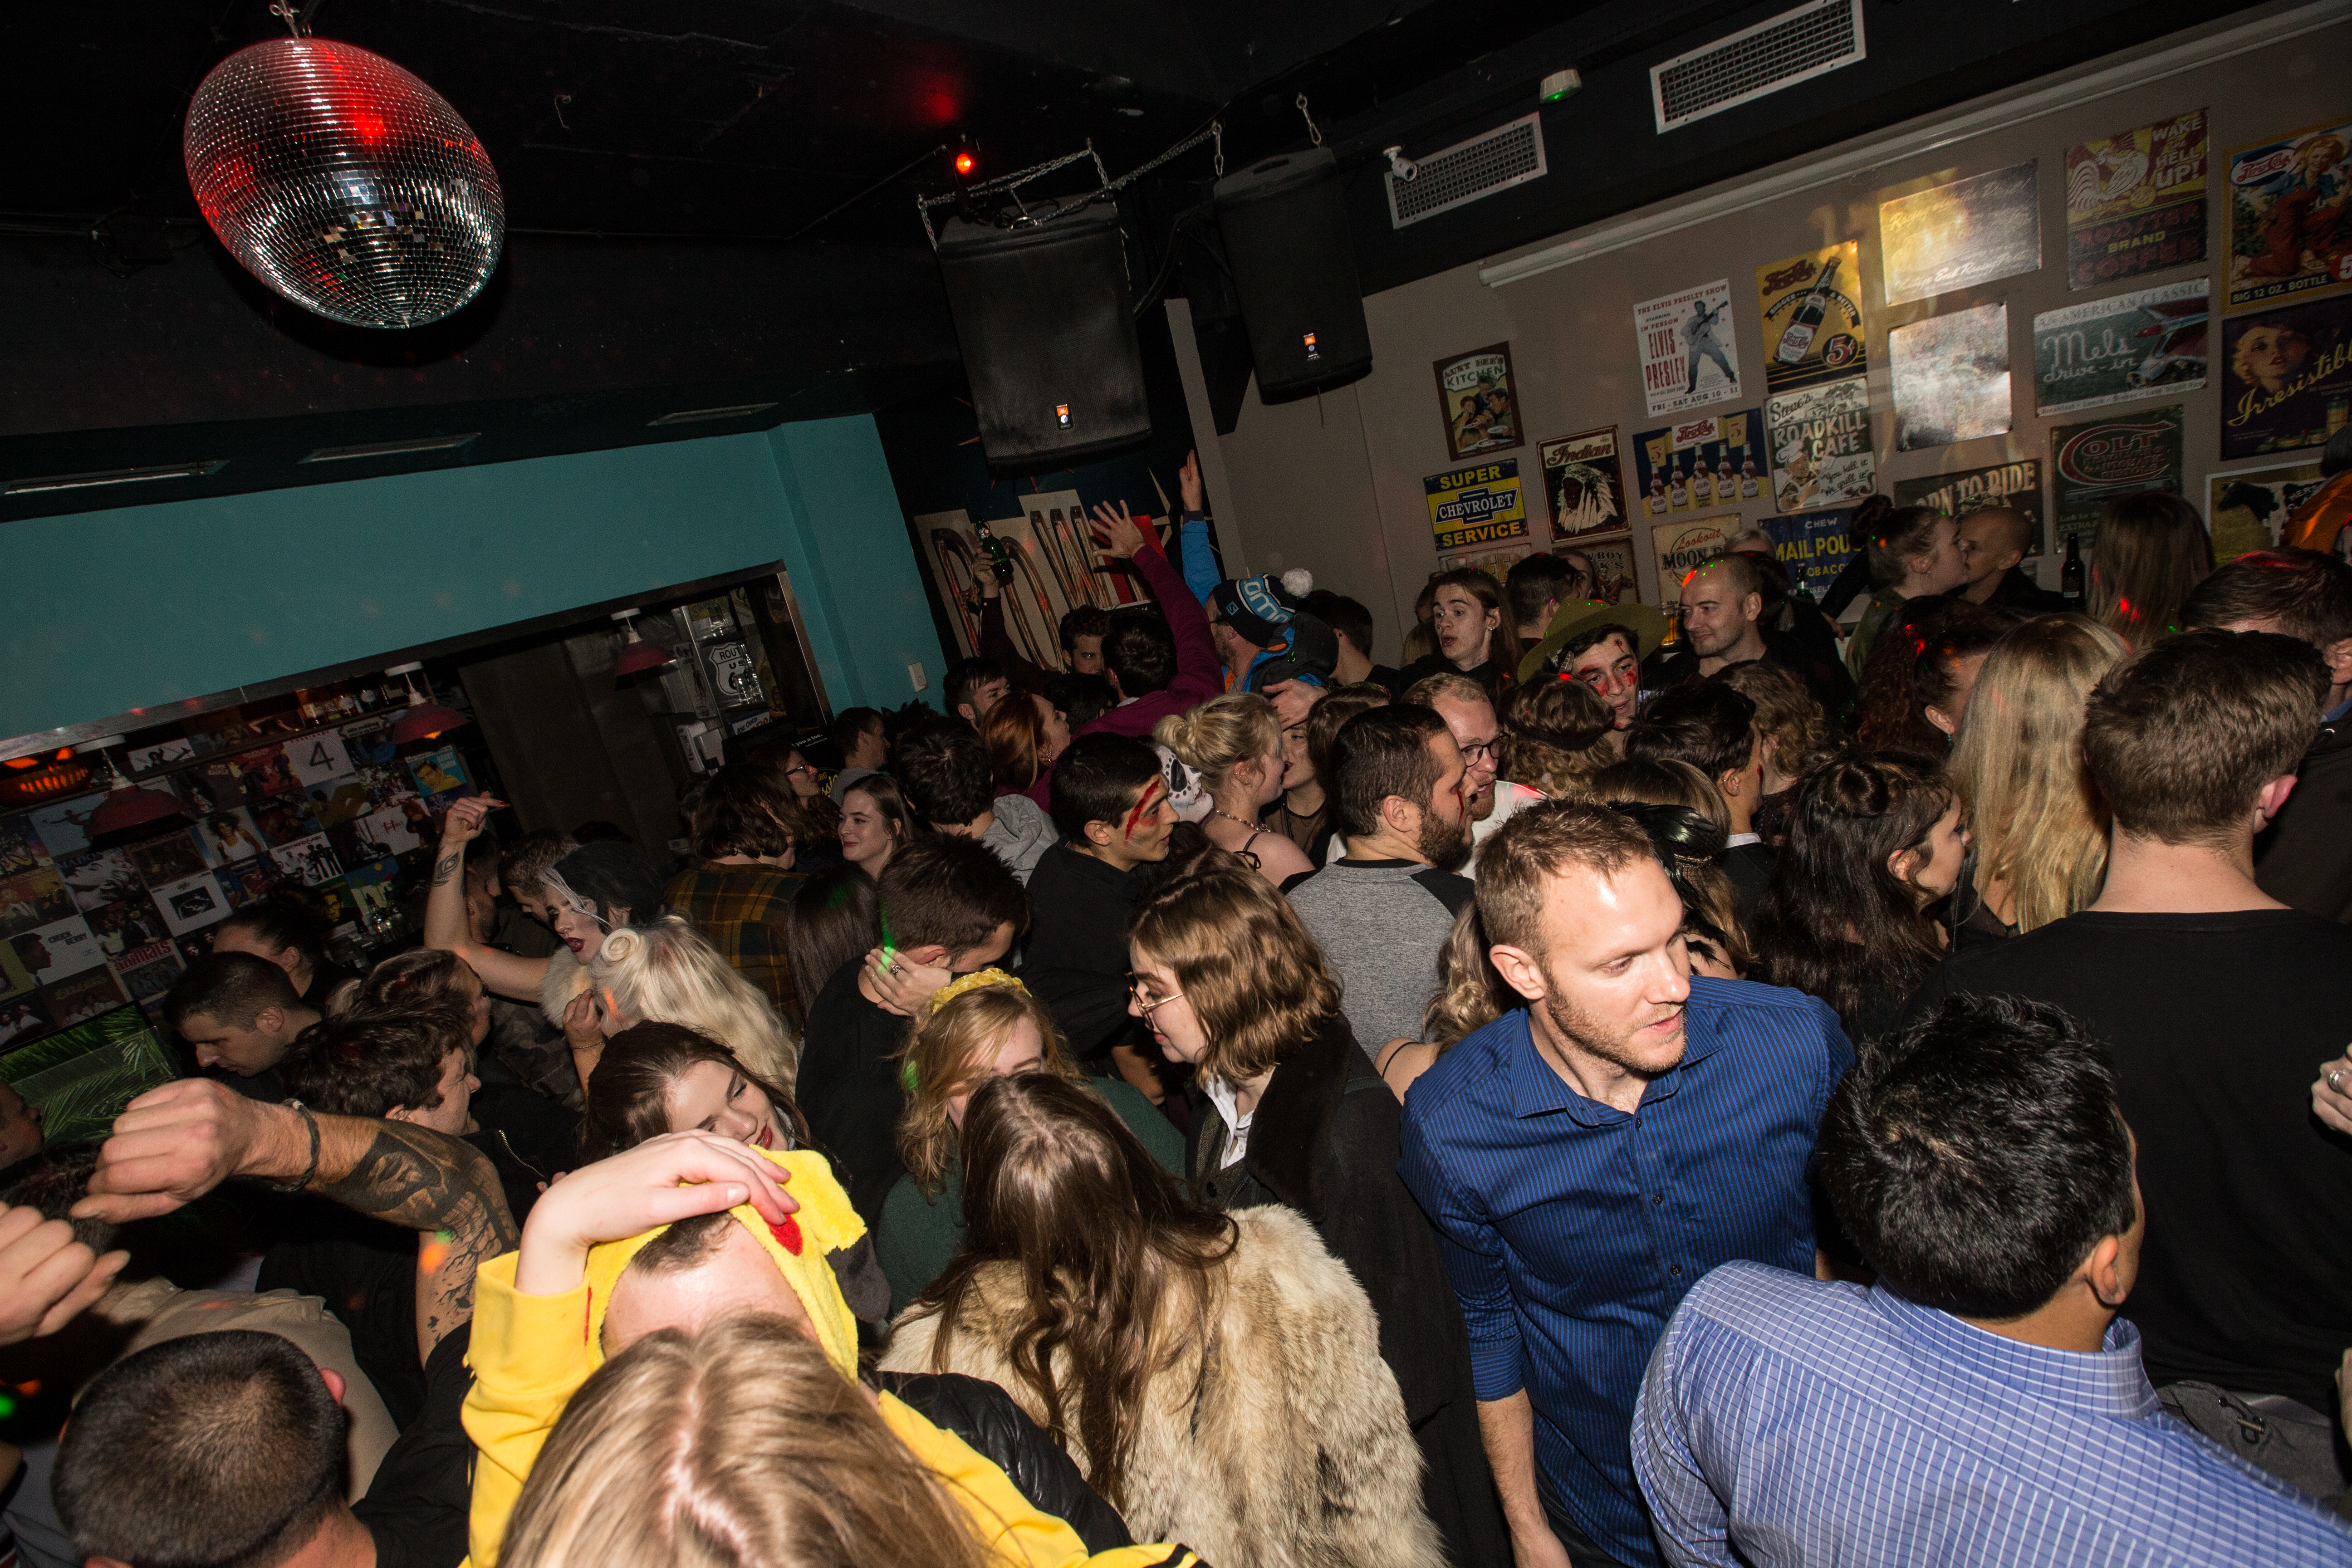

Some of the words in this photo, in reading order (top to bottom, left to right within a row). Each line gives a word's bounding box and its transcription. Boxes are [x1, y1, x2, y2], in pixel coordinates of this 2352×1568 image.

[2152, 120, 2202, 142] WAKE
[2156, 147, 2201, 168] HELL
[2156, 161, 2200, 189] UP!
[2075, 203, 2200, 247] ROOSTER
[2107, 230, 2166, 254] BRAND
[2078, 236, 2200, 282] COFFEE
[1637, 306, 1651, 315] THE
[1653, 301, 1672, 310] ELVIS
[1674, 291, 1703, 304] PRESLEY
[1706, 284, 1727, 296] SHOW
[2232, 291, 2251, 303] BIG
[2253, 287, 2265, 298] 12
[2268, 282, 2285, 294] OZ.
[2288, 274, 2328, 291] BOTTLE
[1837, 293, 1856, 317] BETTER
[2061, 296, 2136, 323] AMERICAN
[2138, 282, 2205, 306] CLASSIC
[1651, 318, 1678, 330] PERSON
[1648, 328, 1676, 359] ELVIS
[2043, 328, 2137, 368] Mels
[1444, 362, 1471, 379] AUNT
[1446, 364, 1504, 388] KITCHEN
[1646, 356, 1686, 390] PRESLEY
[2043, 357, 2139, 383] drive-in
[1652, 403, 1666, 411] FRI
[1673, 397, 1688, 407] SAT
[1692, 393, 1709, 403] AUG
[1713, 390, 1721, 398] 10
[1769, 392, 1813, 422] Steve's
[1774, 411, 1867, 448] ROADKILL
[1546, 443, 1612, 467] Indian
[1812, 431, 1860, 459] CAFE
[2082, 445, 2165, 466] REVOLVERS
[1440, 466, 1502, 490] SUPER
[2102, 463, 2158, 479] PISTOLS
[1955, 475, 1984, 502] TO
[1439, 493, 1513, 519] CHEVROLET
[1442, 522, 1521, 547] SERVICE
[1805, 517, 1838, 529] CHEW
[1676, 528, 1721, 551] Lookout
[1816, 534, 1862, 556] POU
[931, 505, 1130, 675] POW
[719, 646, 741, 660] ROUT
[309, 741, 334, 770] 4
[56, 851, 104, 869] MADON
[48, 931, 73, 944] CHUCK
[64, 932, 88, 946] BERRY
[114, 941, 172, 971] animals
